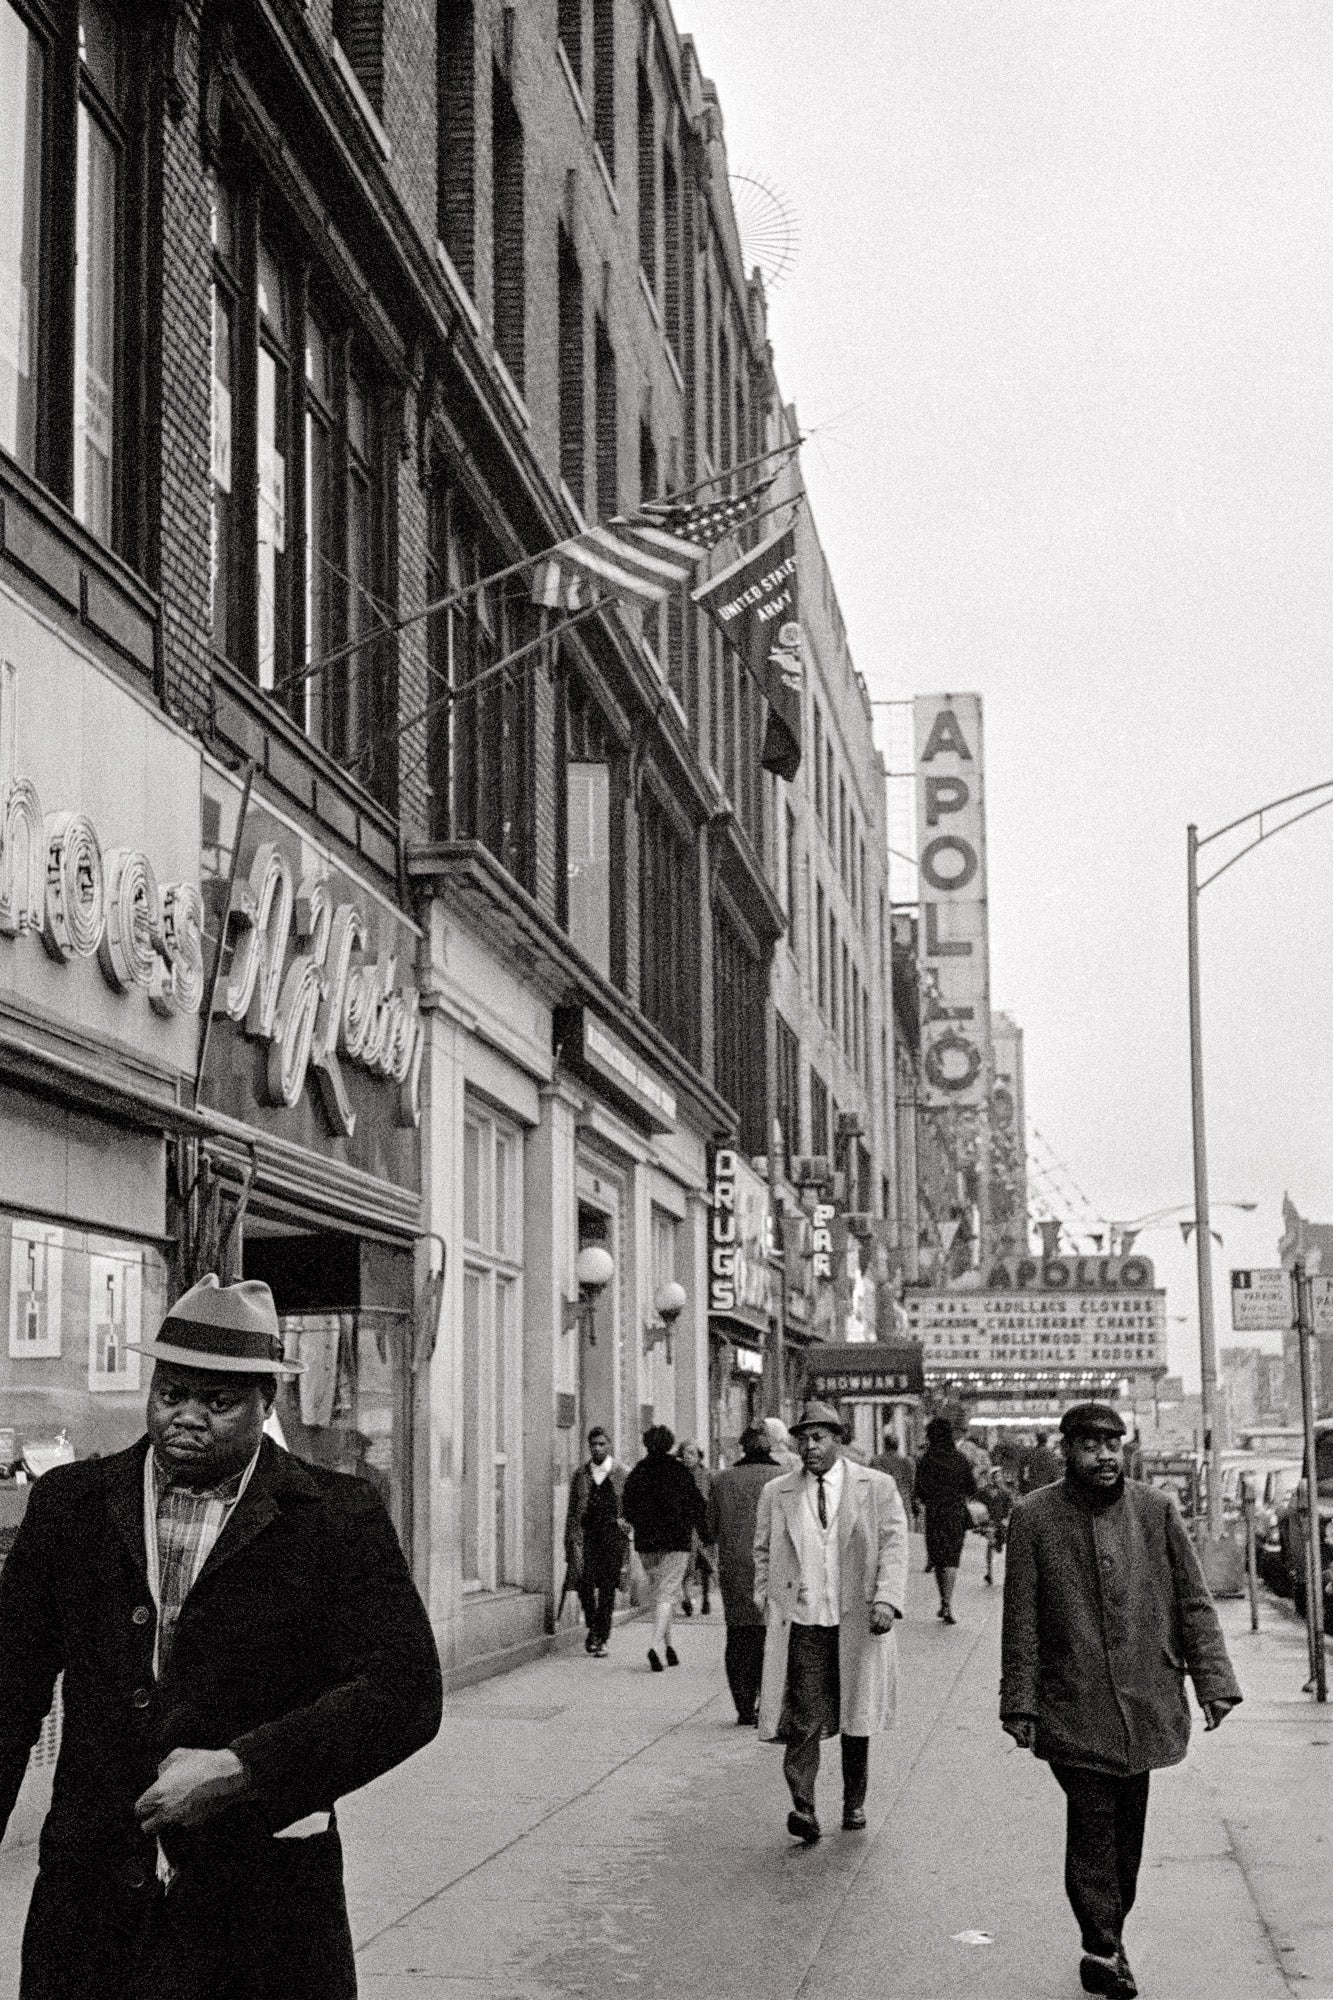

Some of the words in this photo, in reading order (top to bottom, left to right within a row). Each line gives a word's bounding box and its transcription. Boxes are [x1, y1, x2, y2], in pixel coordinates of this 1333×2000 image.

[717, 585, 763, 621] UNITED
[757, 588, 792, 622] ARMY
[917, 709, 980, 1092] APOLLO
[712, 1149, 739, 1311] DRUGS
[986, 1258, 1148, 1289] APOLLO
[1079, 1300, 1153, 1313] CLOVERS
[990, 1332, 1081, 1345] HOLLYWOOD
[1093, 1332, 1156, 1345] FLAMES
[1096, 1317, 1155, 1329] CHANTS
[989, 1348, 1076, 1360] IMPERIALS
